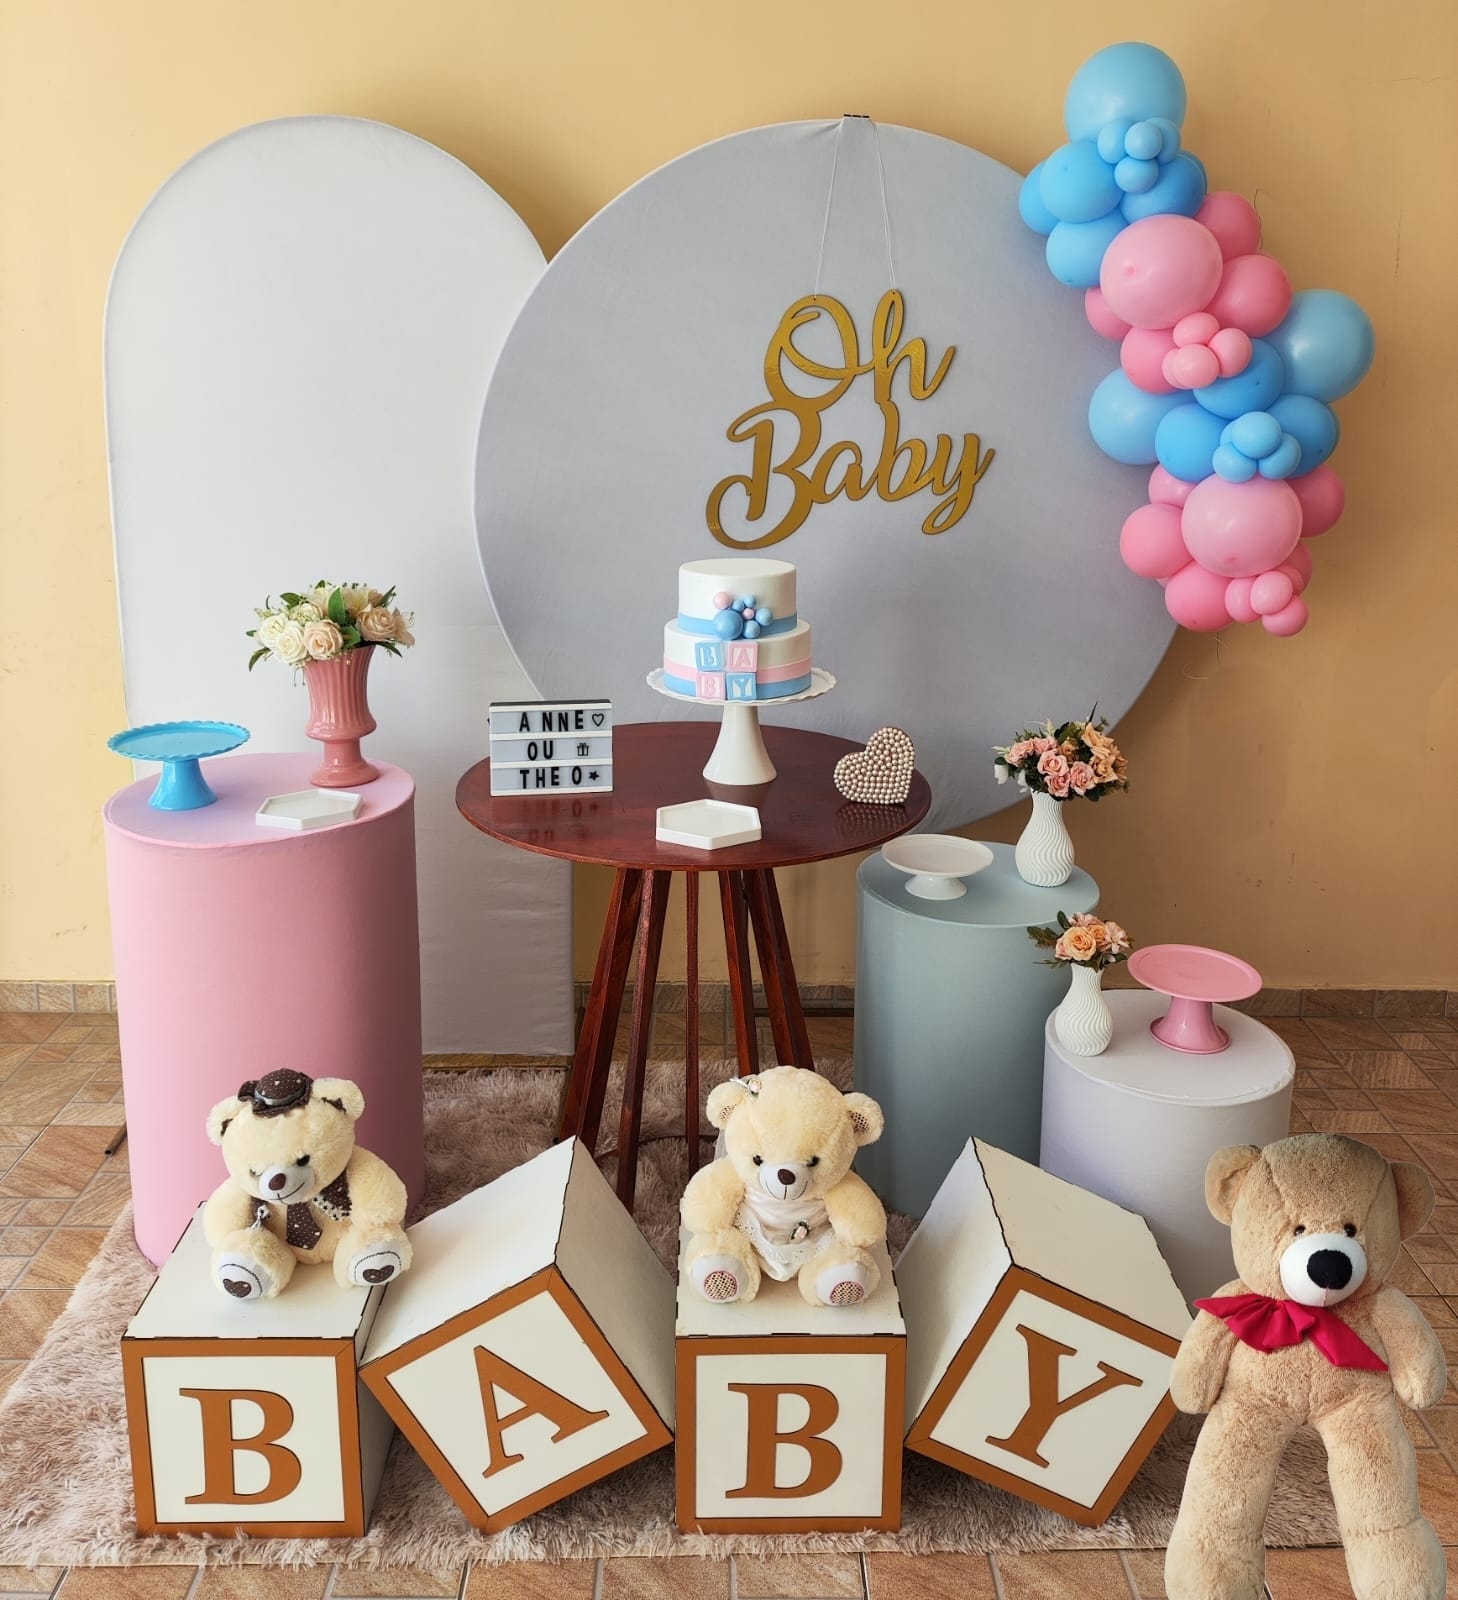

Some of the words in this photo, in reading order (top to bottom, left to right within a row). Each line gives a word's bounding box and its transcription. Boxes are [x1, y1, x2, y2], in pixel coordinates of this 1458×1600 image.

[764, 289, 957, 413] Oh
[706, 400, 996, 550] Baby
[527, 740, 553, 761] OU
